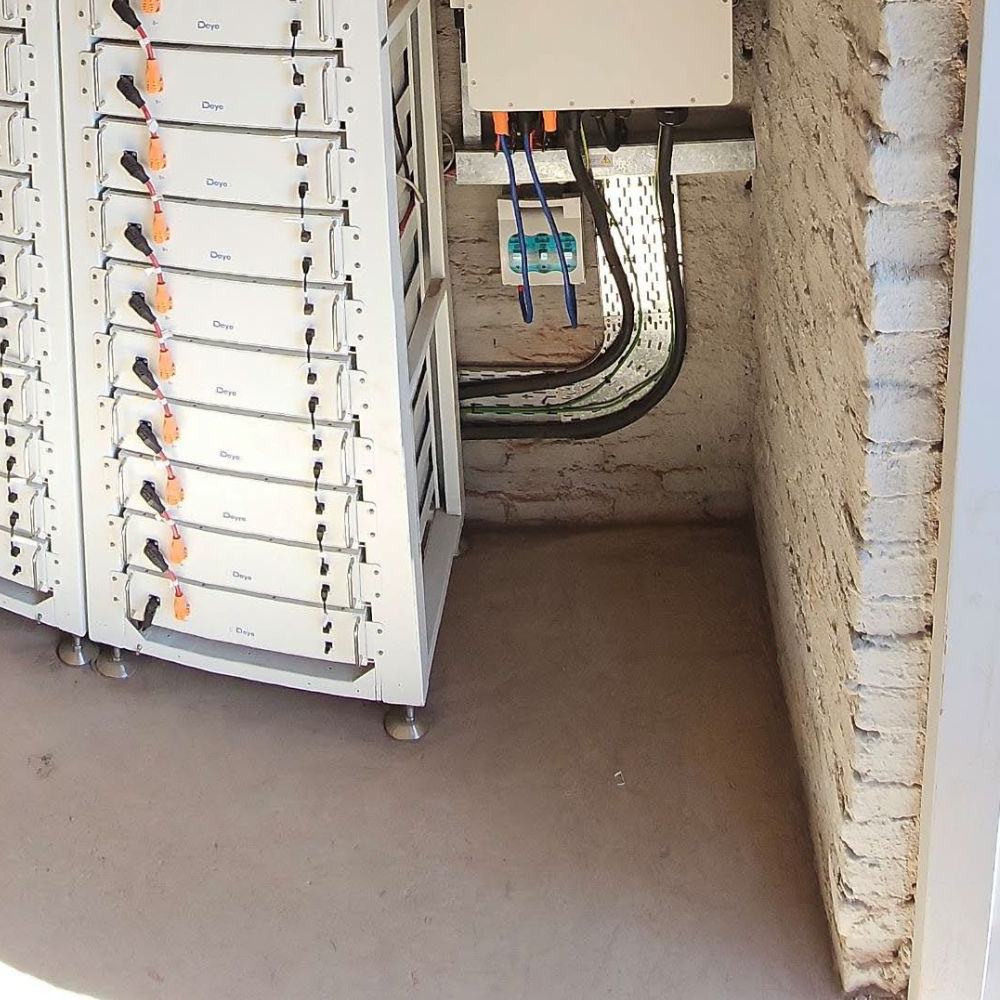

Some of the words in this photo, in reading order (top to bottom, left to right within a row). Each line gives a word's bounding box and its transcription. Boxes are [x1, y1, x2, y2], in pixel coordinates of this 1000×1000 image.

[198, 21, 219, 31] Deye
[202, 101, 223, 111] Deye
[206, 178, 227, 188] Deye
